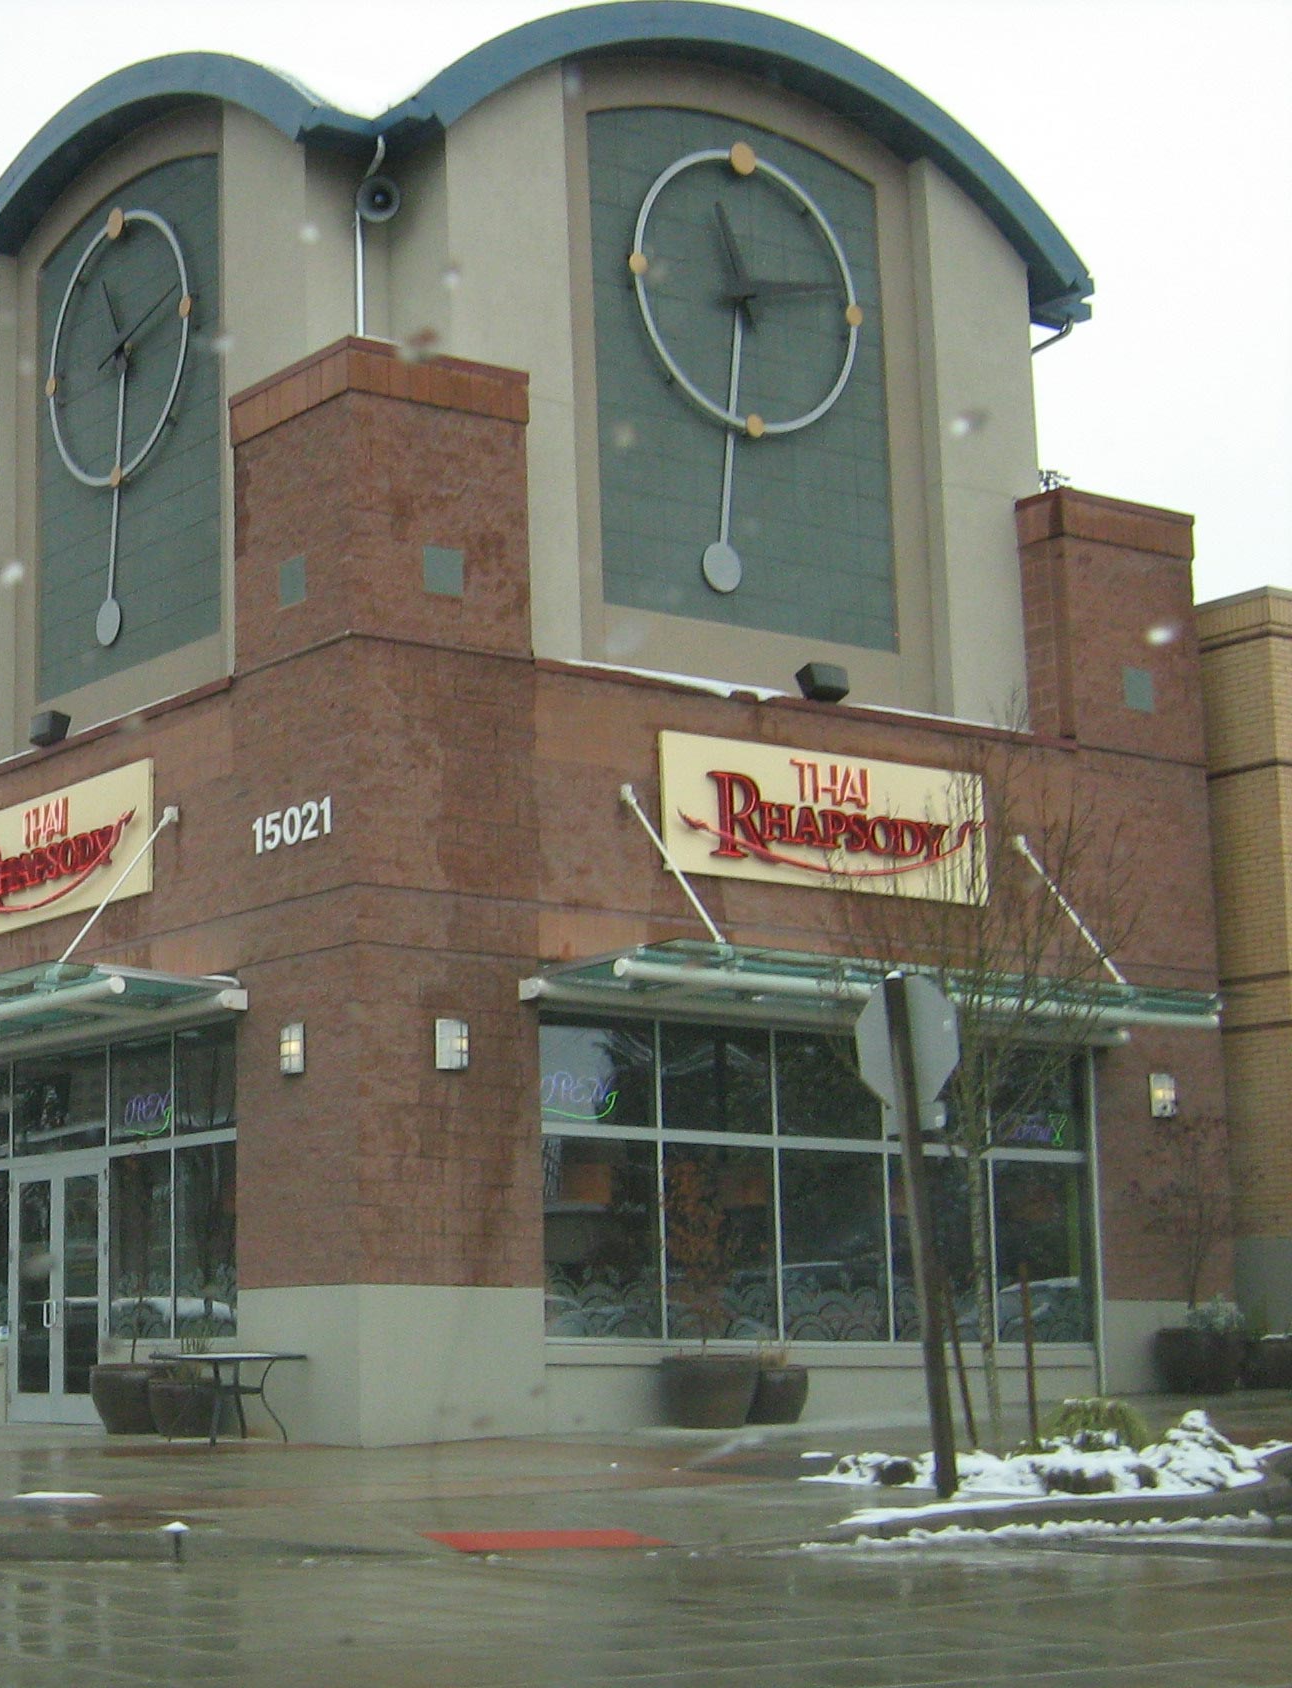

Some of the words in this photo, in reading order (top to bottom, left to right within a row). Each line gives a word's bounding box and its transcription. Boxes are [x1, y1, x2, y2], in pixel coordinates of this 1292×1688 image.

[789, 758, 871, 809] THAI
[22, 797, 70, 848] THAI
[251, 795, 333, 856] 15021
[706, 769, 950, 860] RHAPSODY
